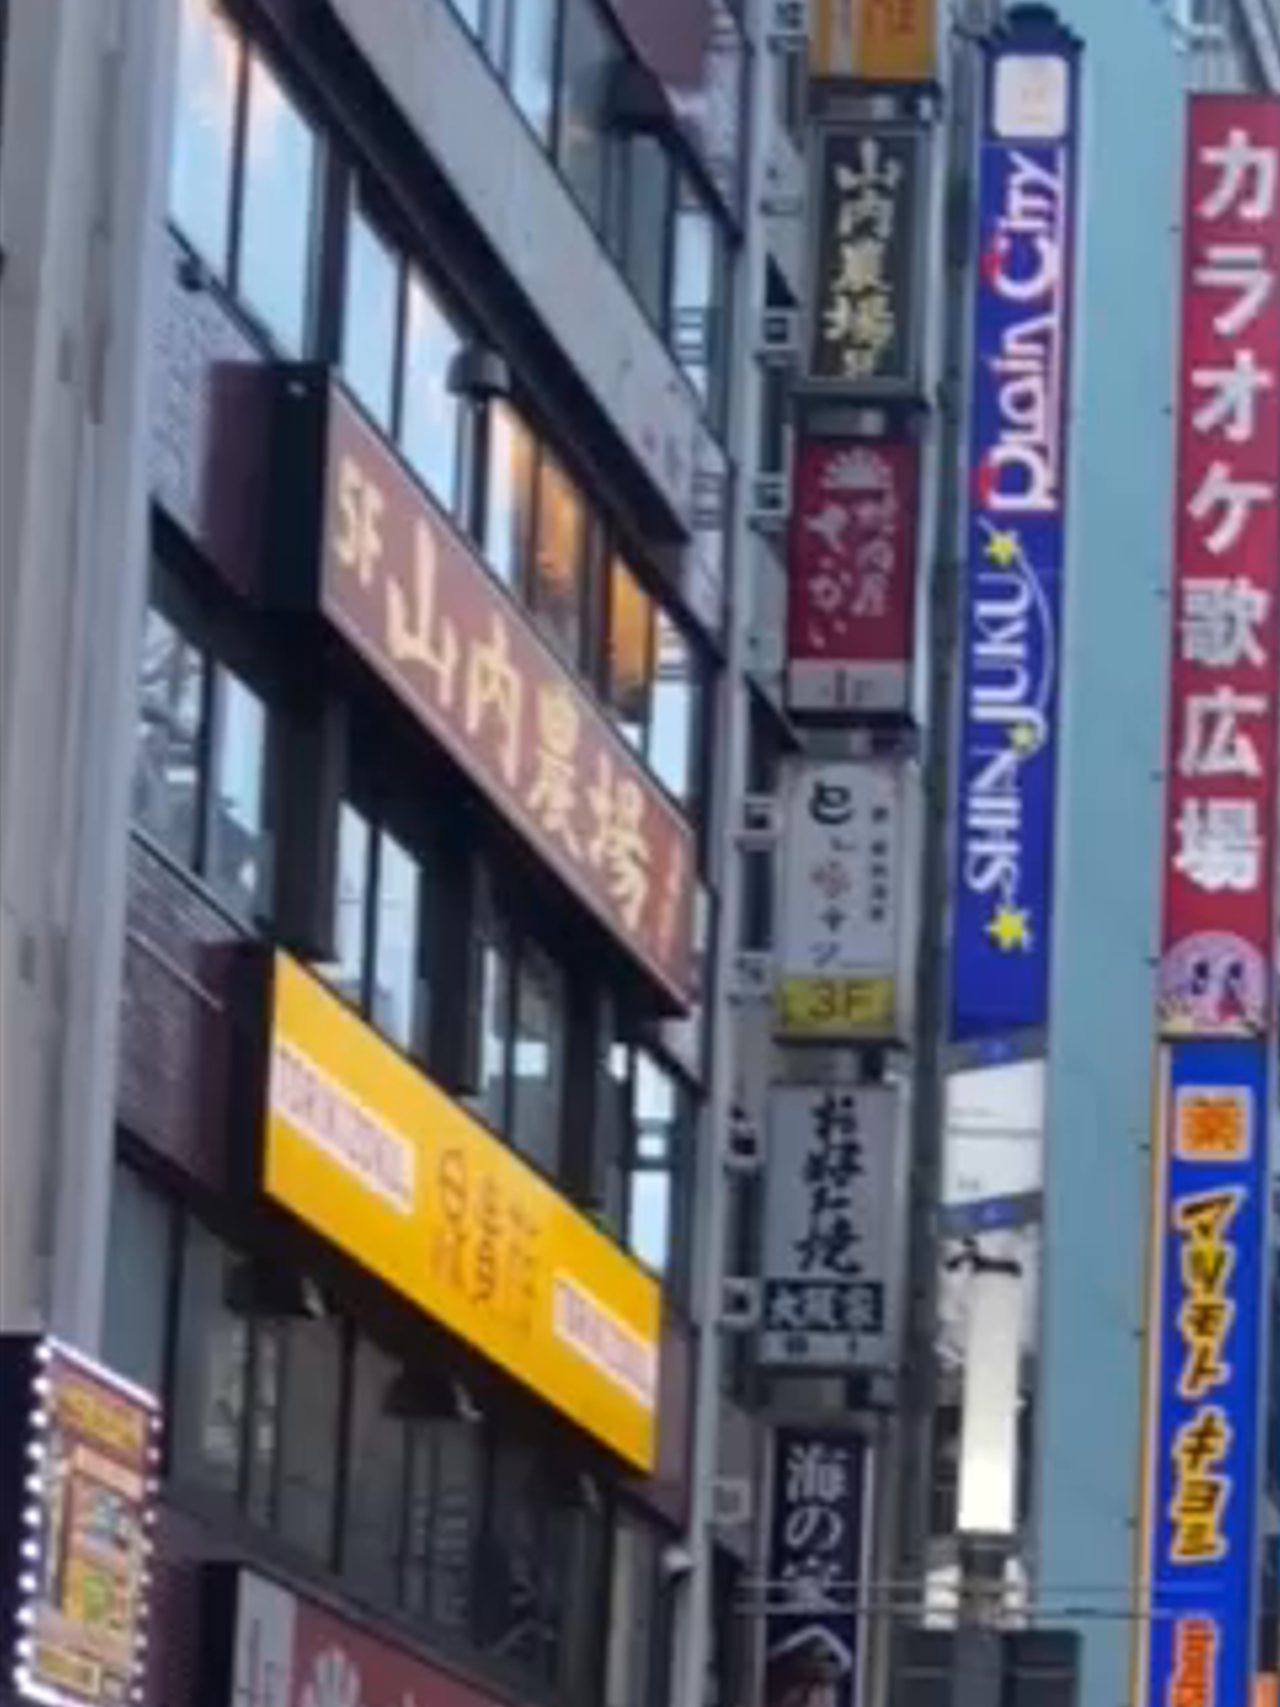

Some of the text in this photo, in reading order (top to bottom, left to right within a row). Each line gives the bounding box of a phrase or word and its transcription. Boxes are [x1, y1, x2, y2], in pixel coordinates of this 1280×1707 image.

[386, 531, 650, 933] 山内農場
[807, 987, 872, 1023] 3F
[1168, 1186, 1252, 1566] マツモトキヨシ
